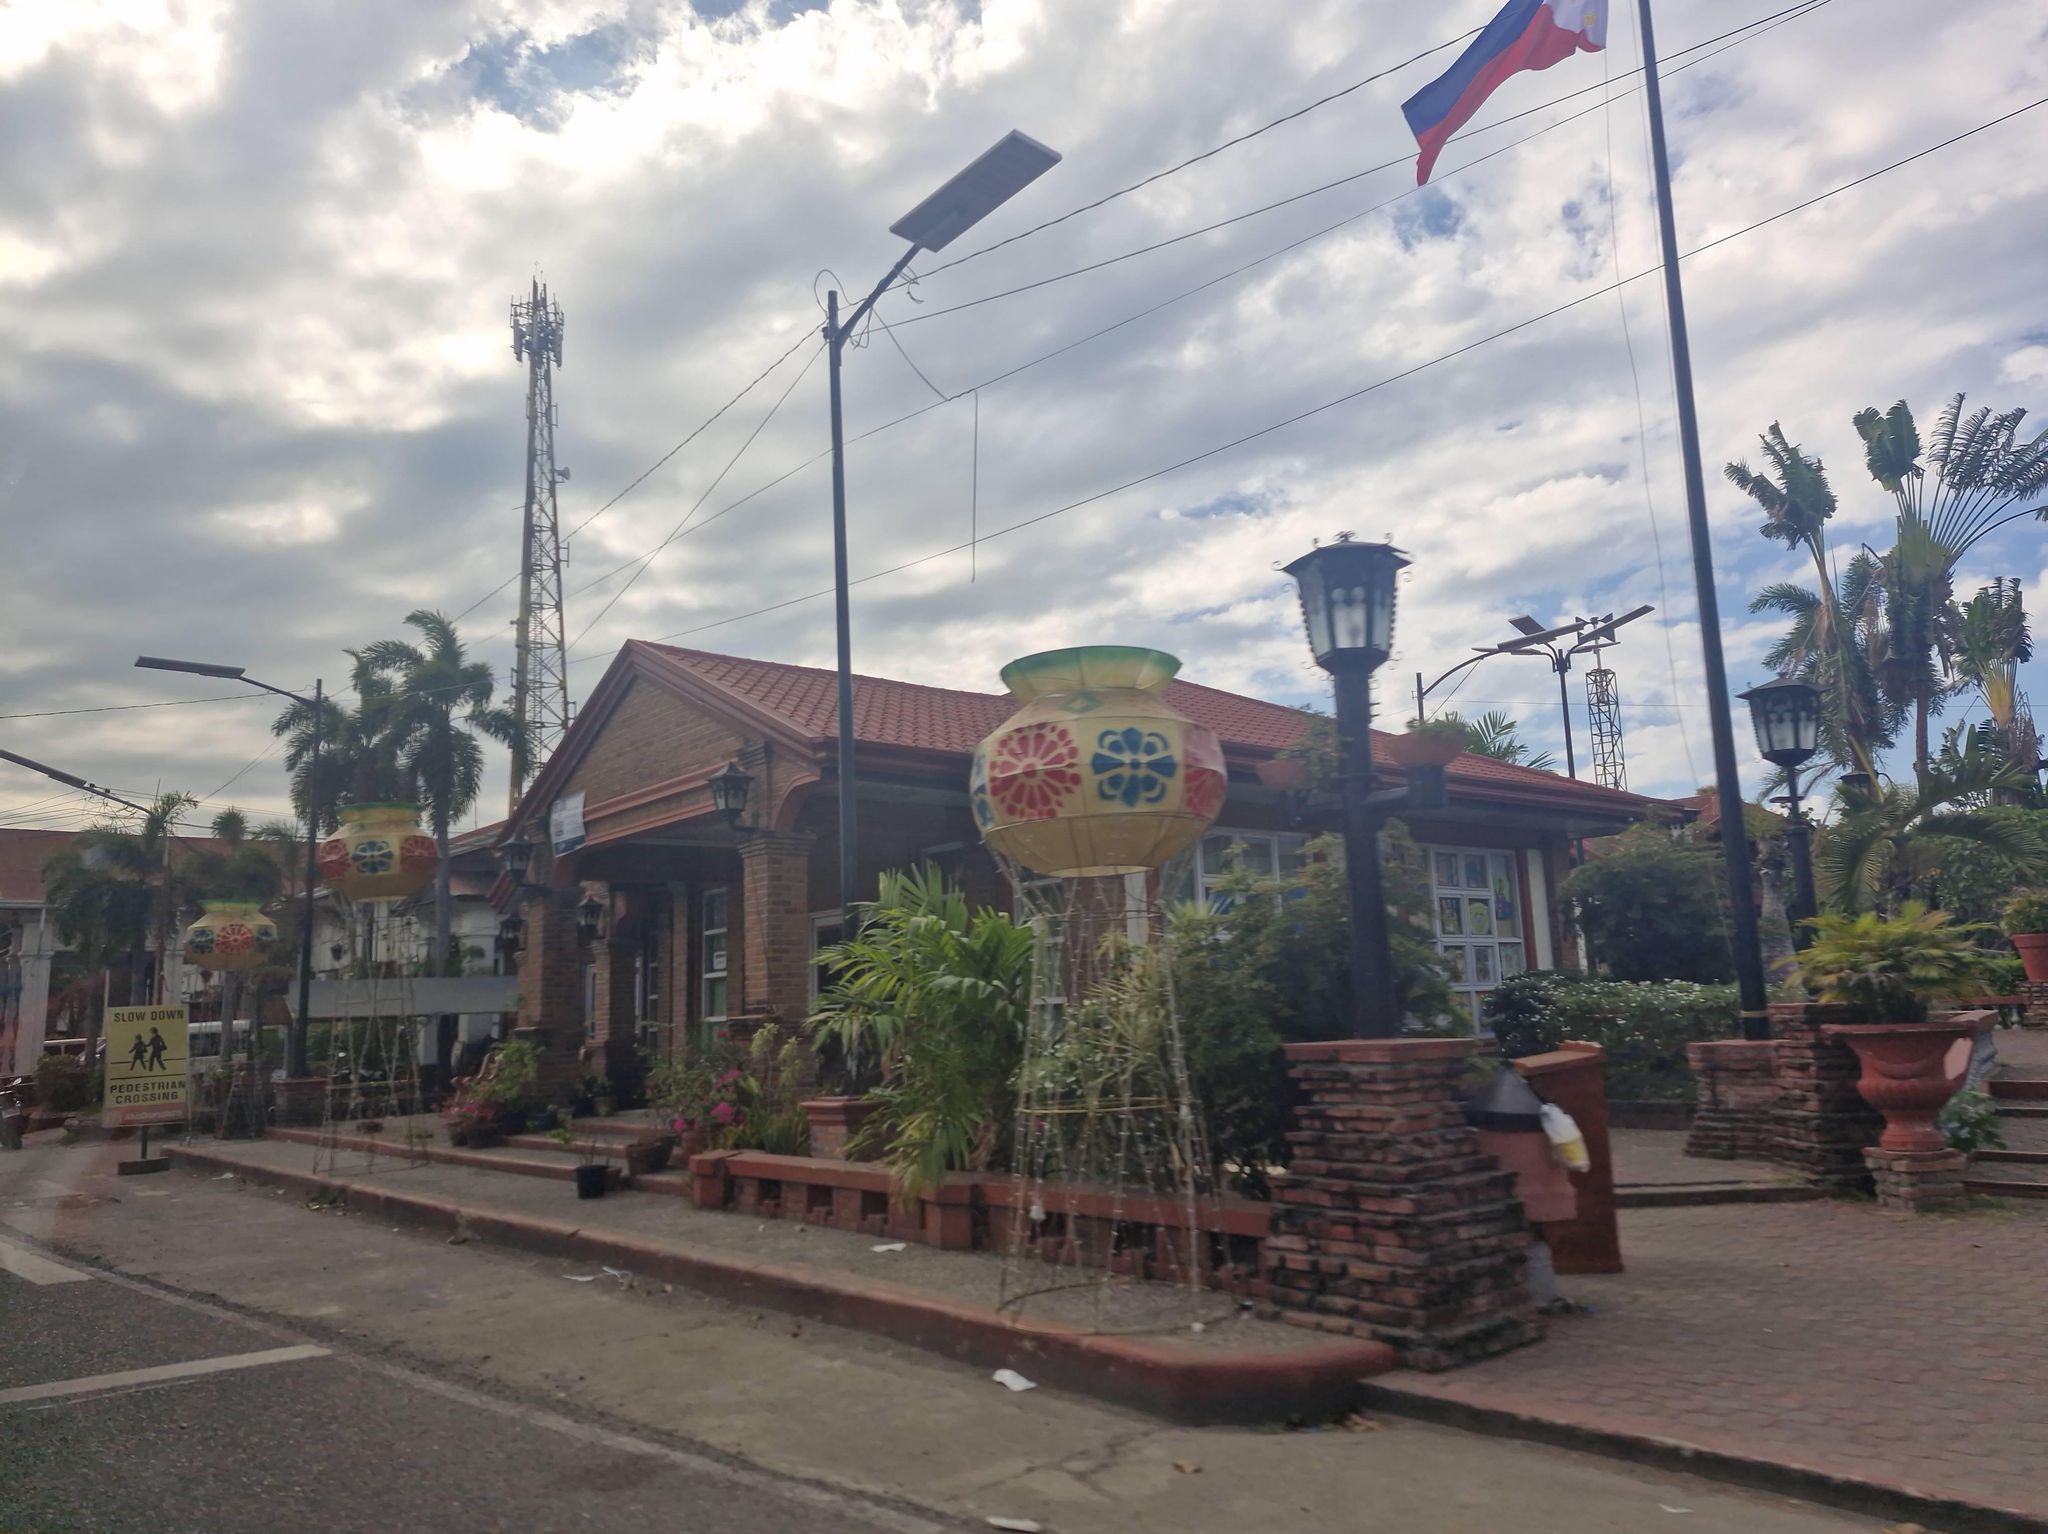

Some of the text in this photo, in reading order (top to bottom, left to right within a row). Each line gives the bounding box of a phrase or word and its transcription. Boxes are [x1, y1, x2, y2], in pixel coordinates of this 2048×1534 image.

[114, 1009, 184, 1023] SLOW DOWN
[110, 1081, 186, 1094] PEDESTRIAN
[115, 1091, 179, 1104] CROSSING
